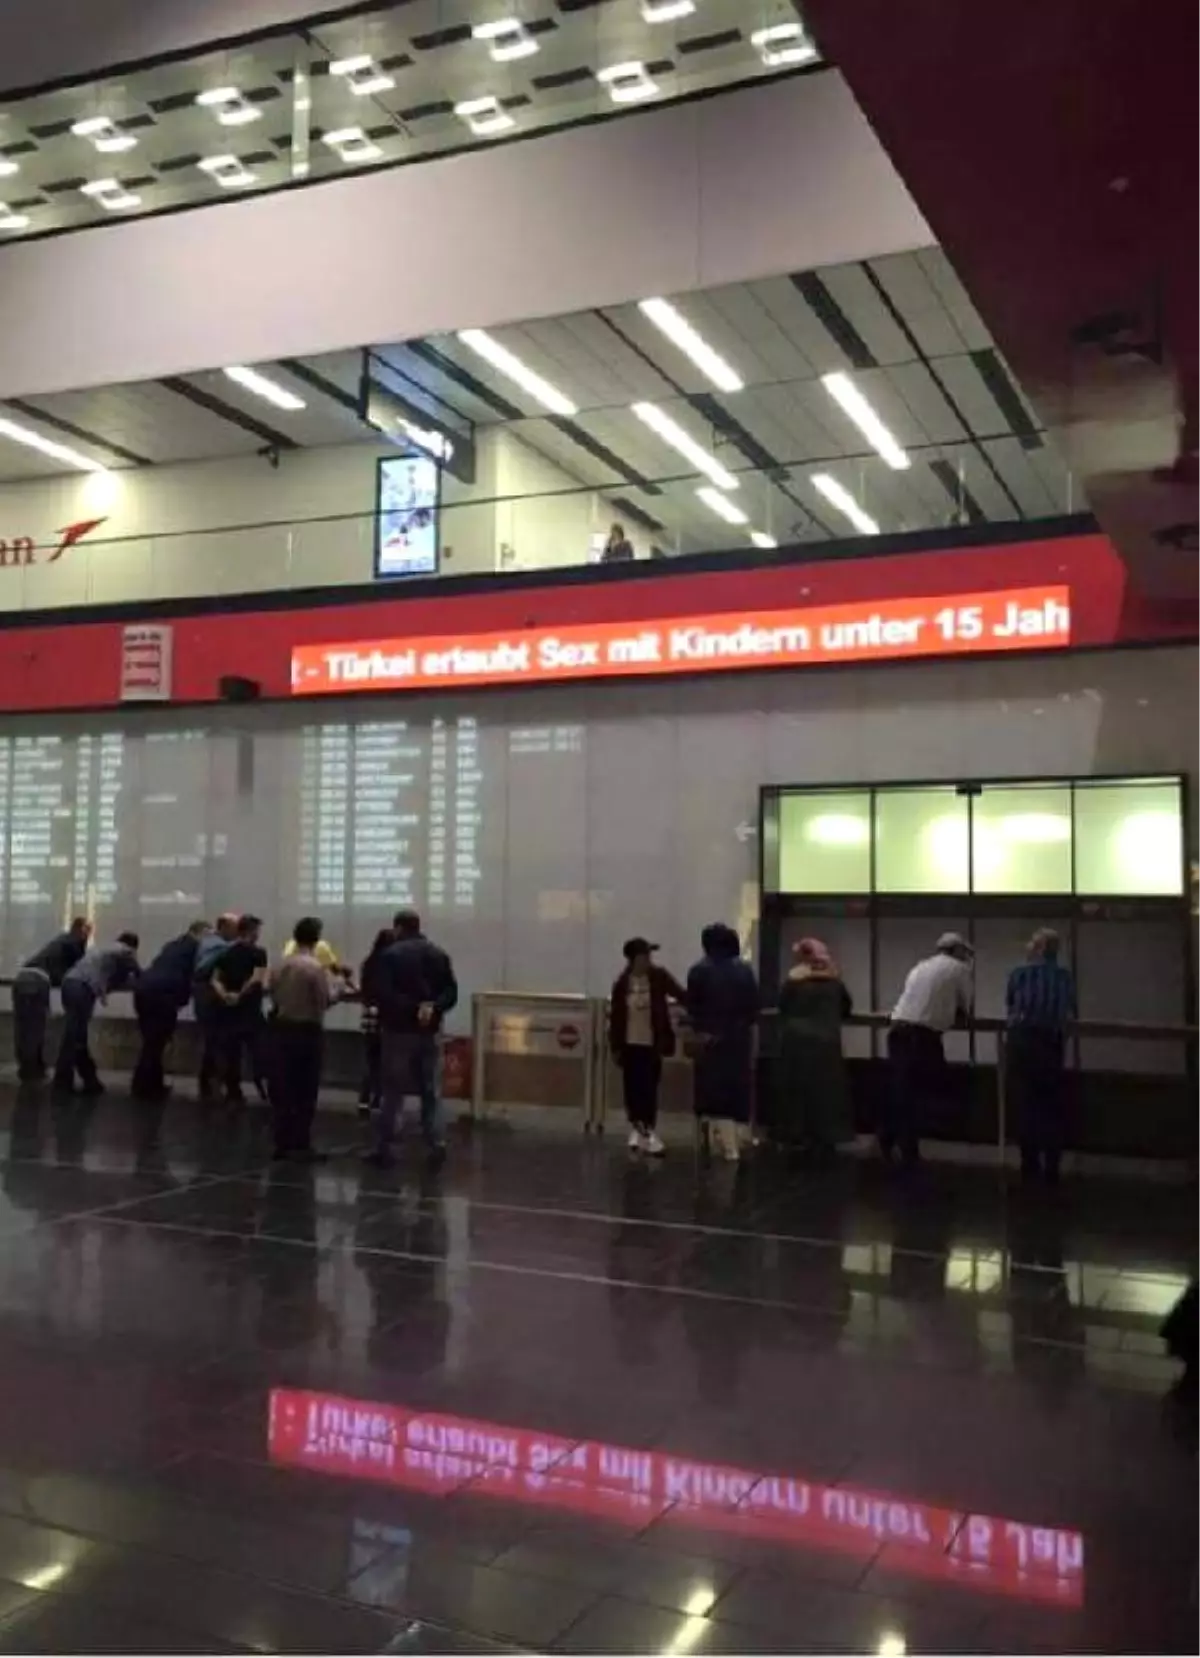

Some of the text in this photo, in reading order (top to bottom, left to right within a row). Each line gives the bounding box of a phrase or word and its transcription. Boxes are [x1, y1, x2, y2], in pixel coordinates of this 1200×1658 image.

[324, 648, 416, 682] Türkei
[421, 641, 531, 675] erlaubt
[539, 638, 600, 667] Sex
[608, 633, 661, 662] mit
[670, 624, 809, 660] Kindern
[821, 614, 923, 649] unter
[935, 606, 984, 640] 15
[992, 600, 1070, 637] Jah
